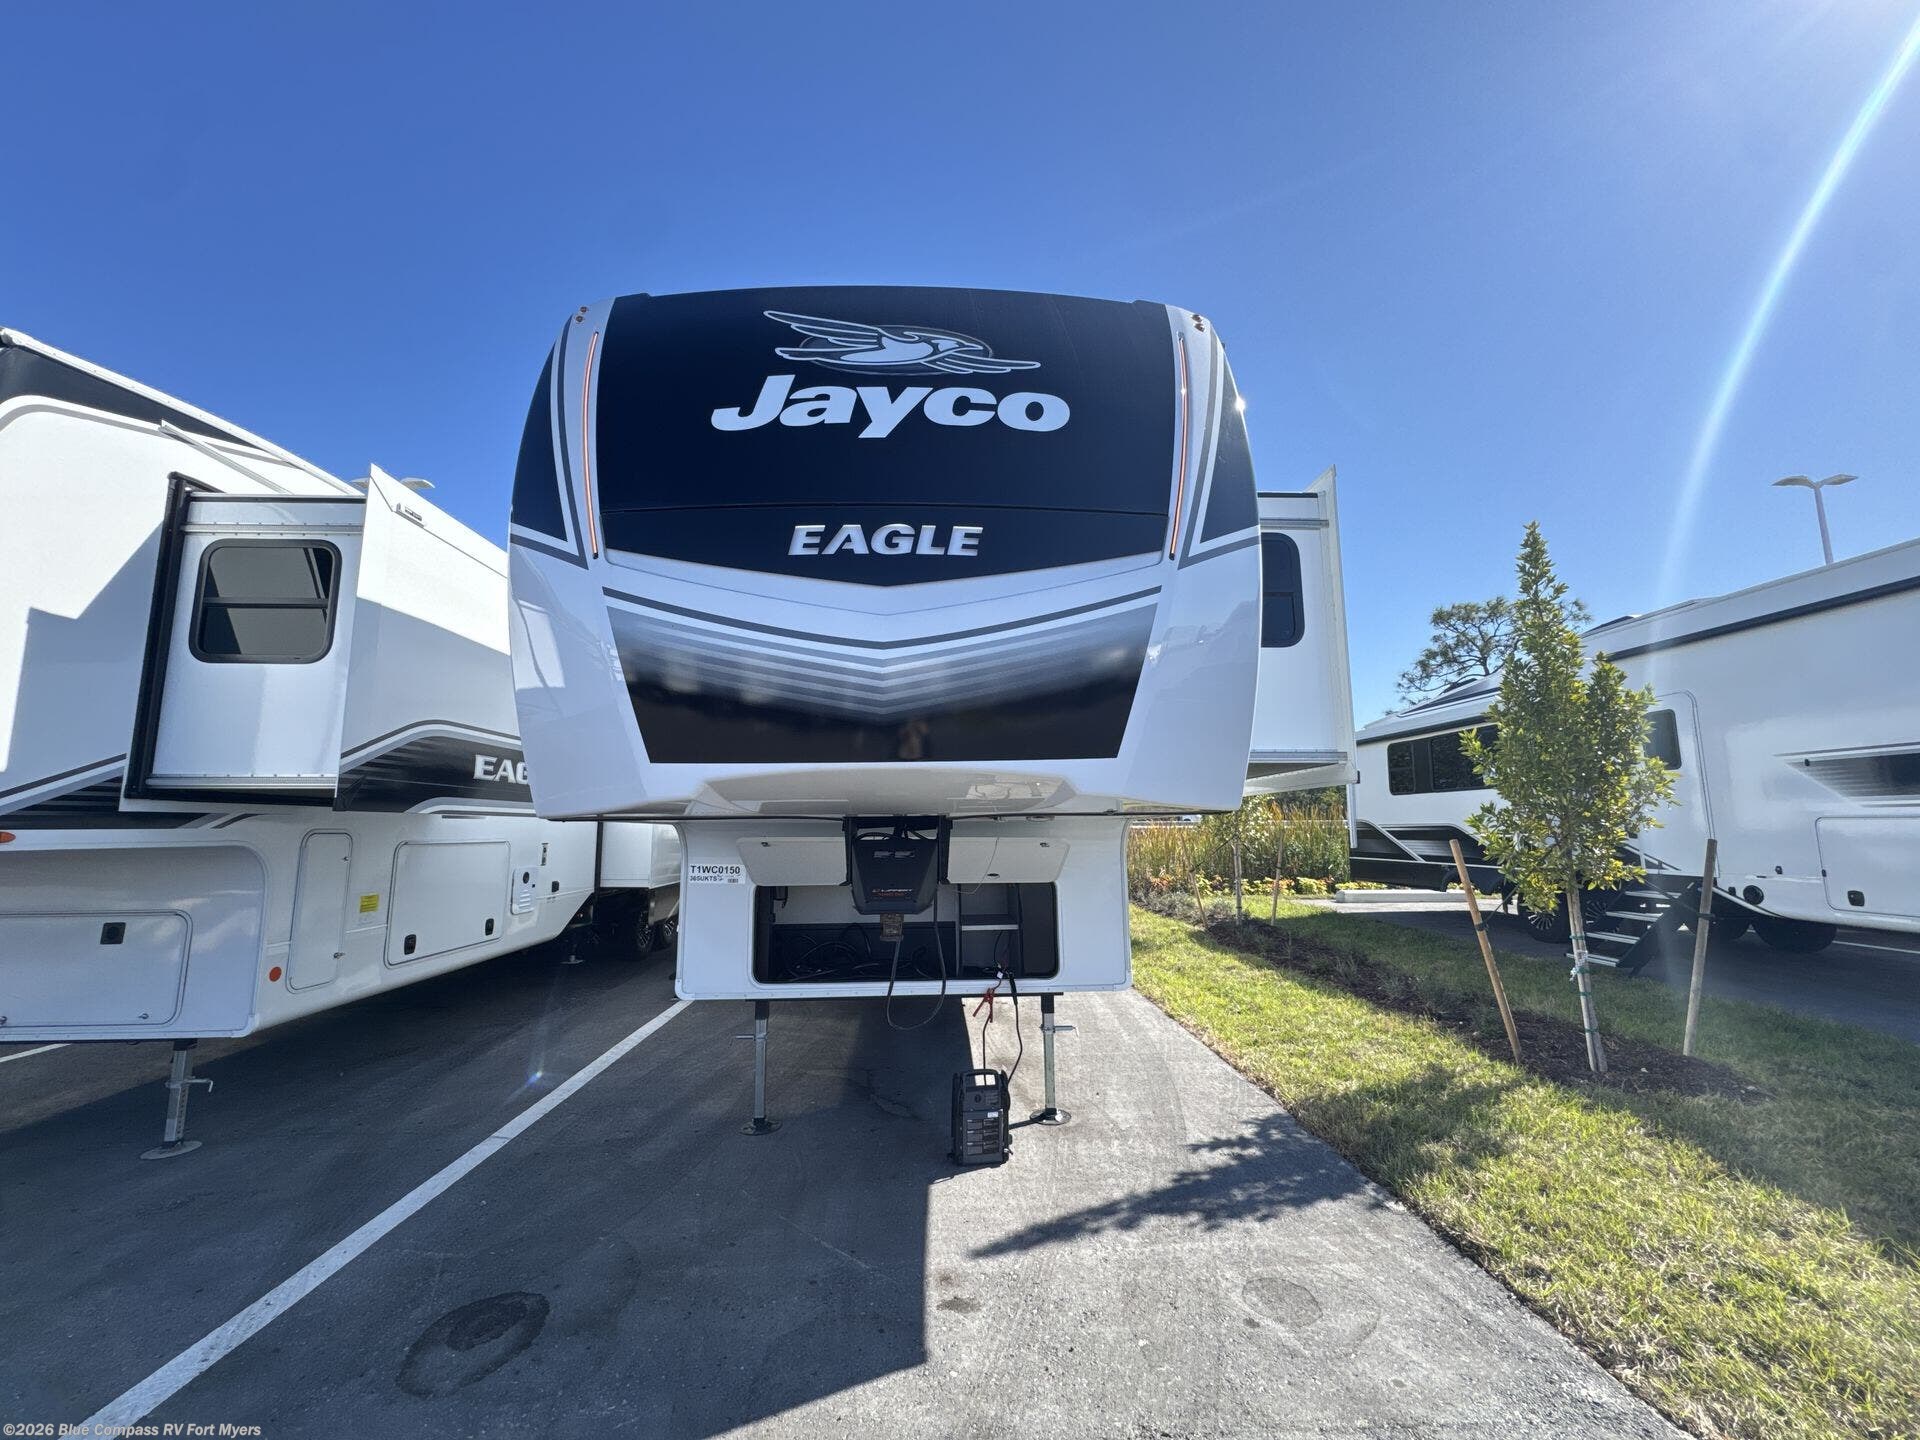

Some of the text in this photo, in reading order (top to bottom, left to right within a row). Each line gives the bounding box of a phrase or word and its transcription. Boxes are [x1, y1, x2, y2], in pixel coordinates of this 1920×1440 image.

[711, 374, 1070, 438] Jayco
[788, 523, 983, 556] EAGLE
[690, 865, 741, 875] T1WC0150
